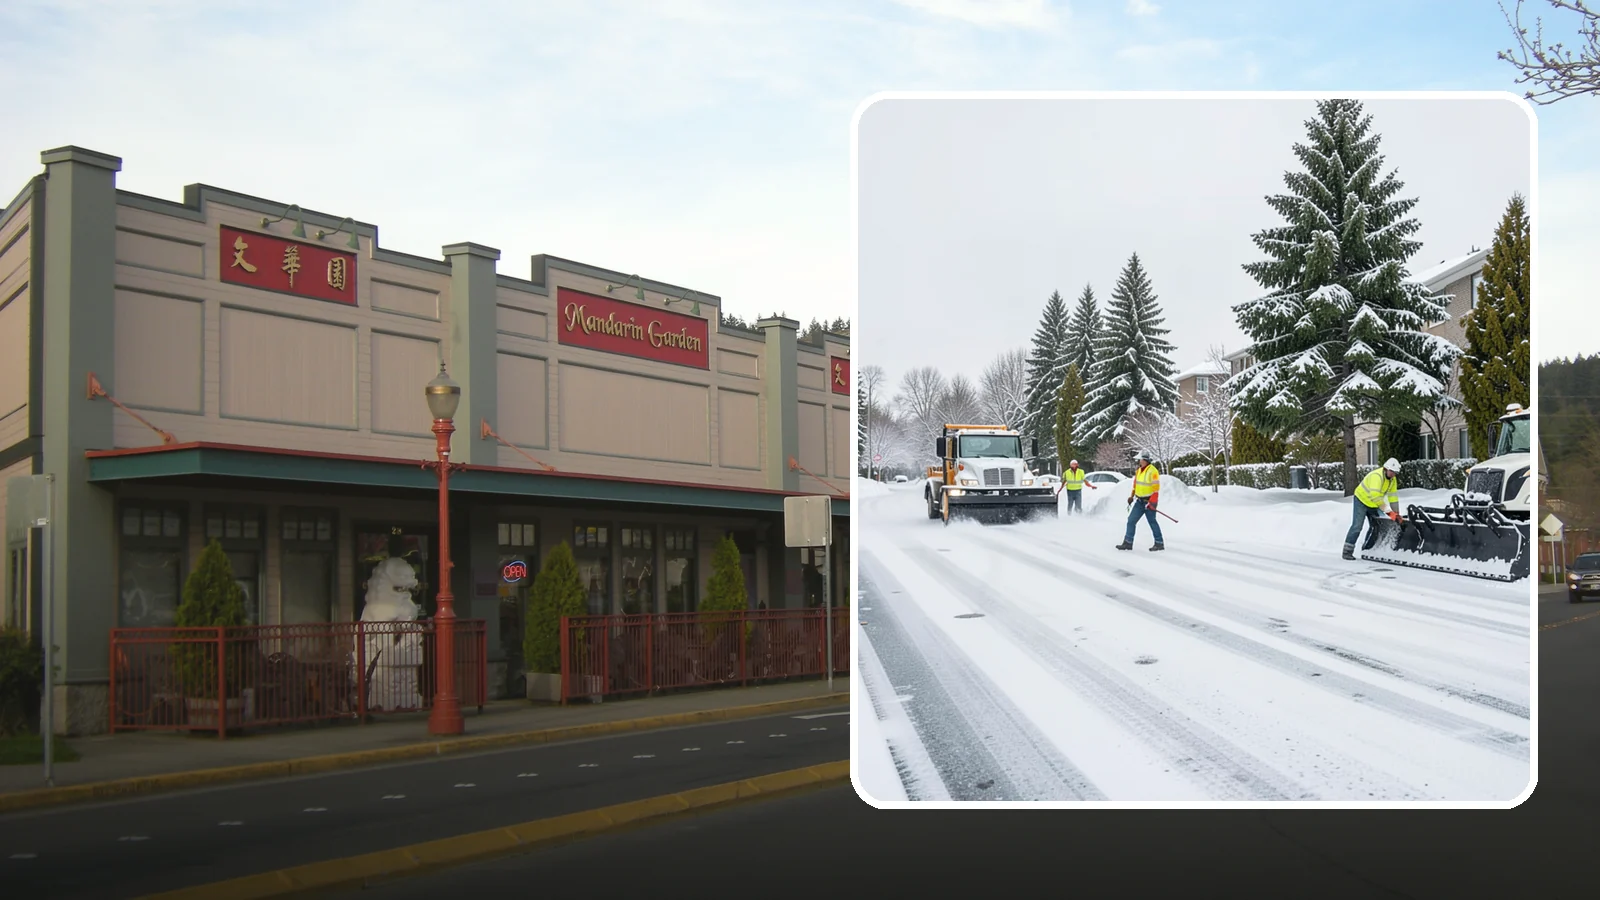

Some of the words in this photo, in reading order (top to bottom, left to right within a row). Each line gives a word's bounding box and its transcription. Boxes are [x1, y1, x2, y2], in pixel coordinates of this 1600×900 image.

[231, 235, 346, 291] 文華園
[564, 302, 644, 340] Mandarin
[647, 320, 702, 352] Garden
[503, 565, 526, 578] OPEN
